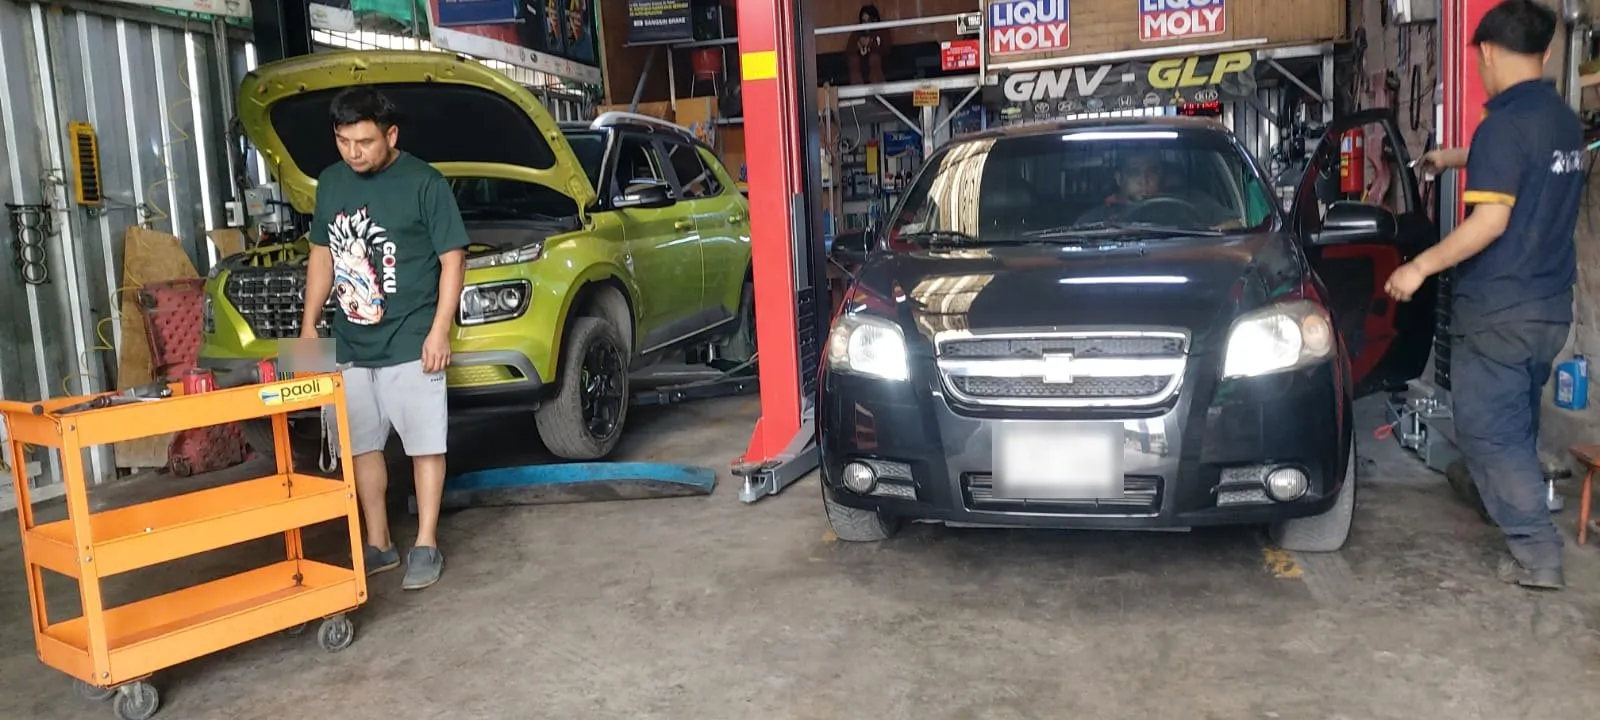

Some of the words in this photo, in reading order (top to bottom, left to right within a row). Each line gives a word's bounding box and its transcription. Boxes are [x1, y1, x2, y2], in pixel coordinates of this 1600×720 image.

[993, 0, 1065, 27] LIQUI
[1144, 7, 1222, 38] MOLY
[994, 23, 1067, 52] MOLY
[1003, 64, 1113, 101] GNV
[1148, 52, 1252, 89] GLP
[382, 241, 397, 293] GOKU
[280, 378, 320, 402] paoli
